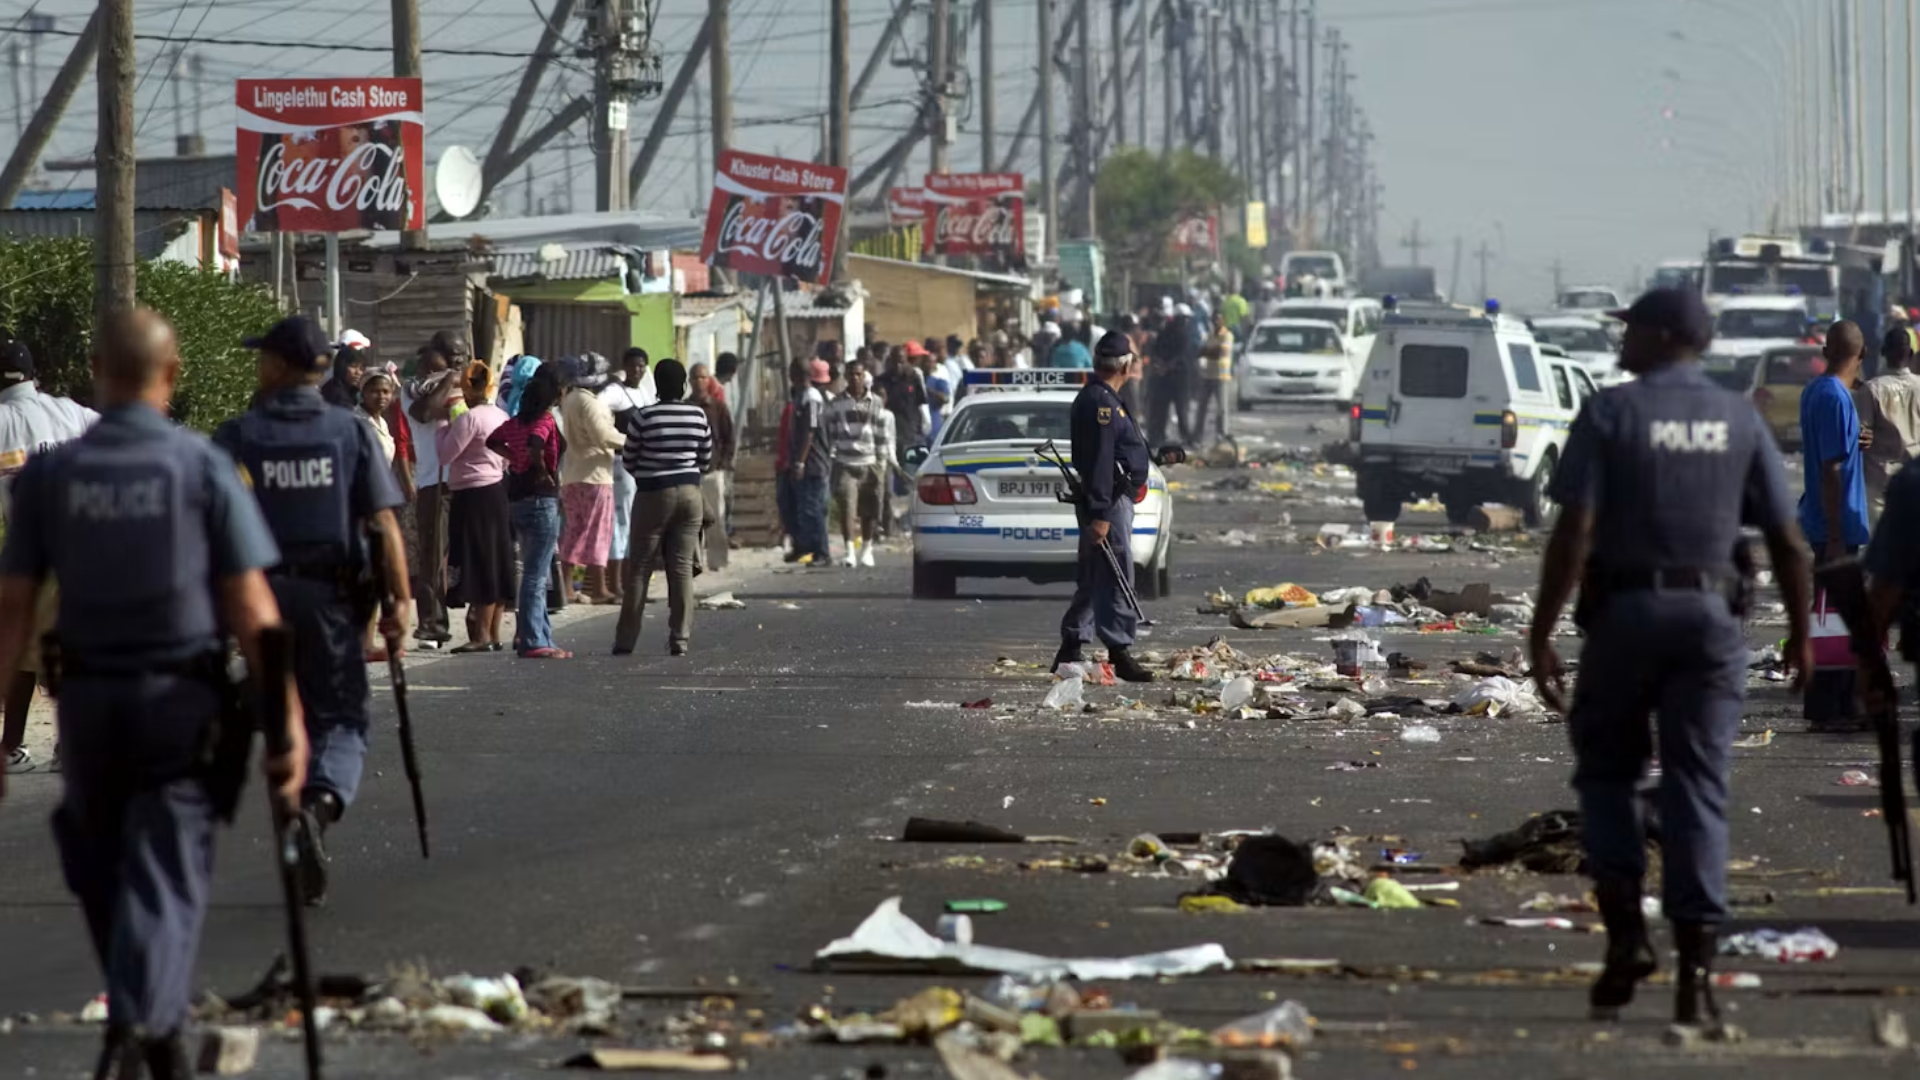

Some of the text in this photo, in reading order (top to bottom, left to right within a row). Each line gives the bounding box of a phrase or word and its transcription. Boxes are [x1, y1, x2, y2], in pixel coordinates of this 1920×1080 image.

[254, 85, 408, 113] Lingelethu Cash Store
[258, 142, 405, 212] Coca-Cola
[730, 158, 835, 190] Khuster Cash Store
[718, 202, 822, 267] Coca-Cola
[1012, 371, 1065, 384] POLICE
[1649, 420, 1729, 452] POLICE
[262, 458, 334, 488] POLICE
[1000, 482, 1025, 494] BPJ
[1030, 482, 1049, 494] 191
[68, 477, 167, 519] POLICE
[1002, 528, 1062, 540] POLICE
